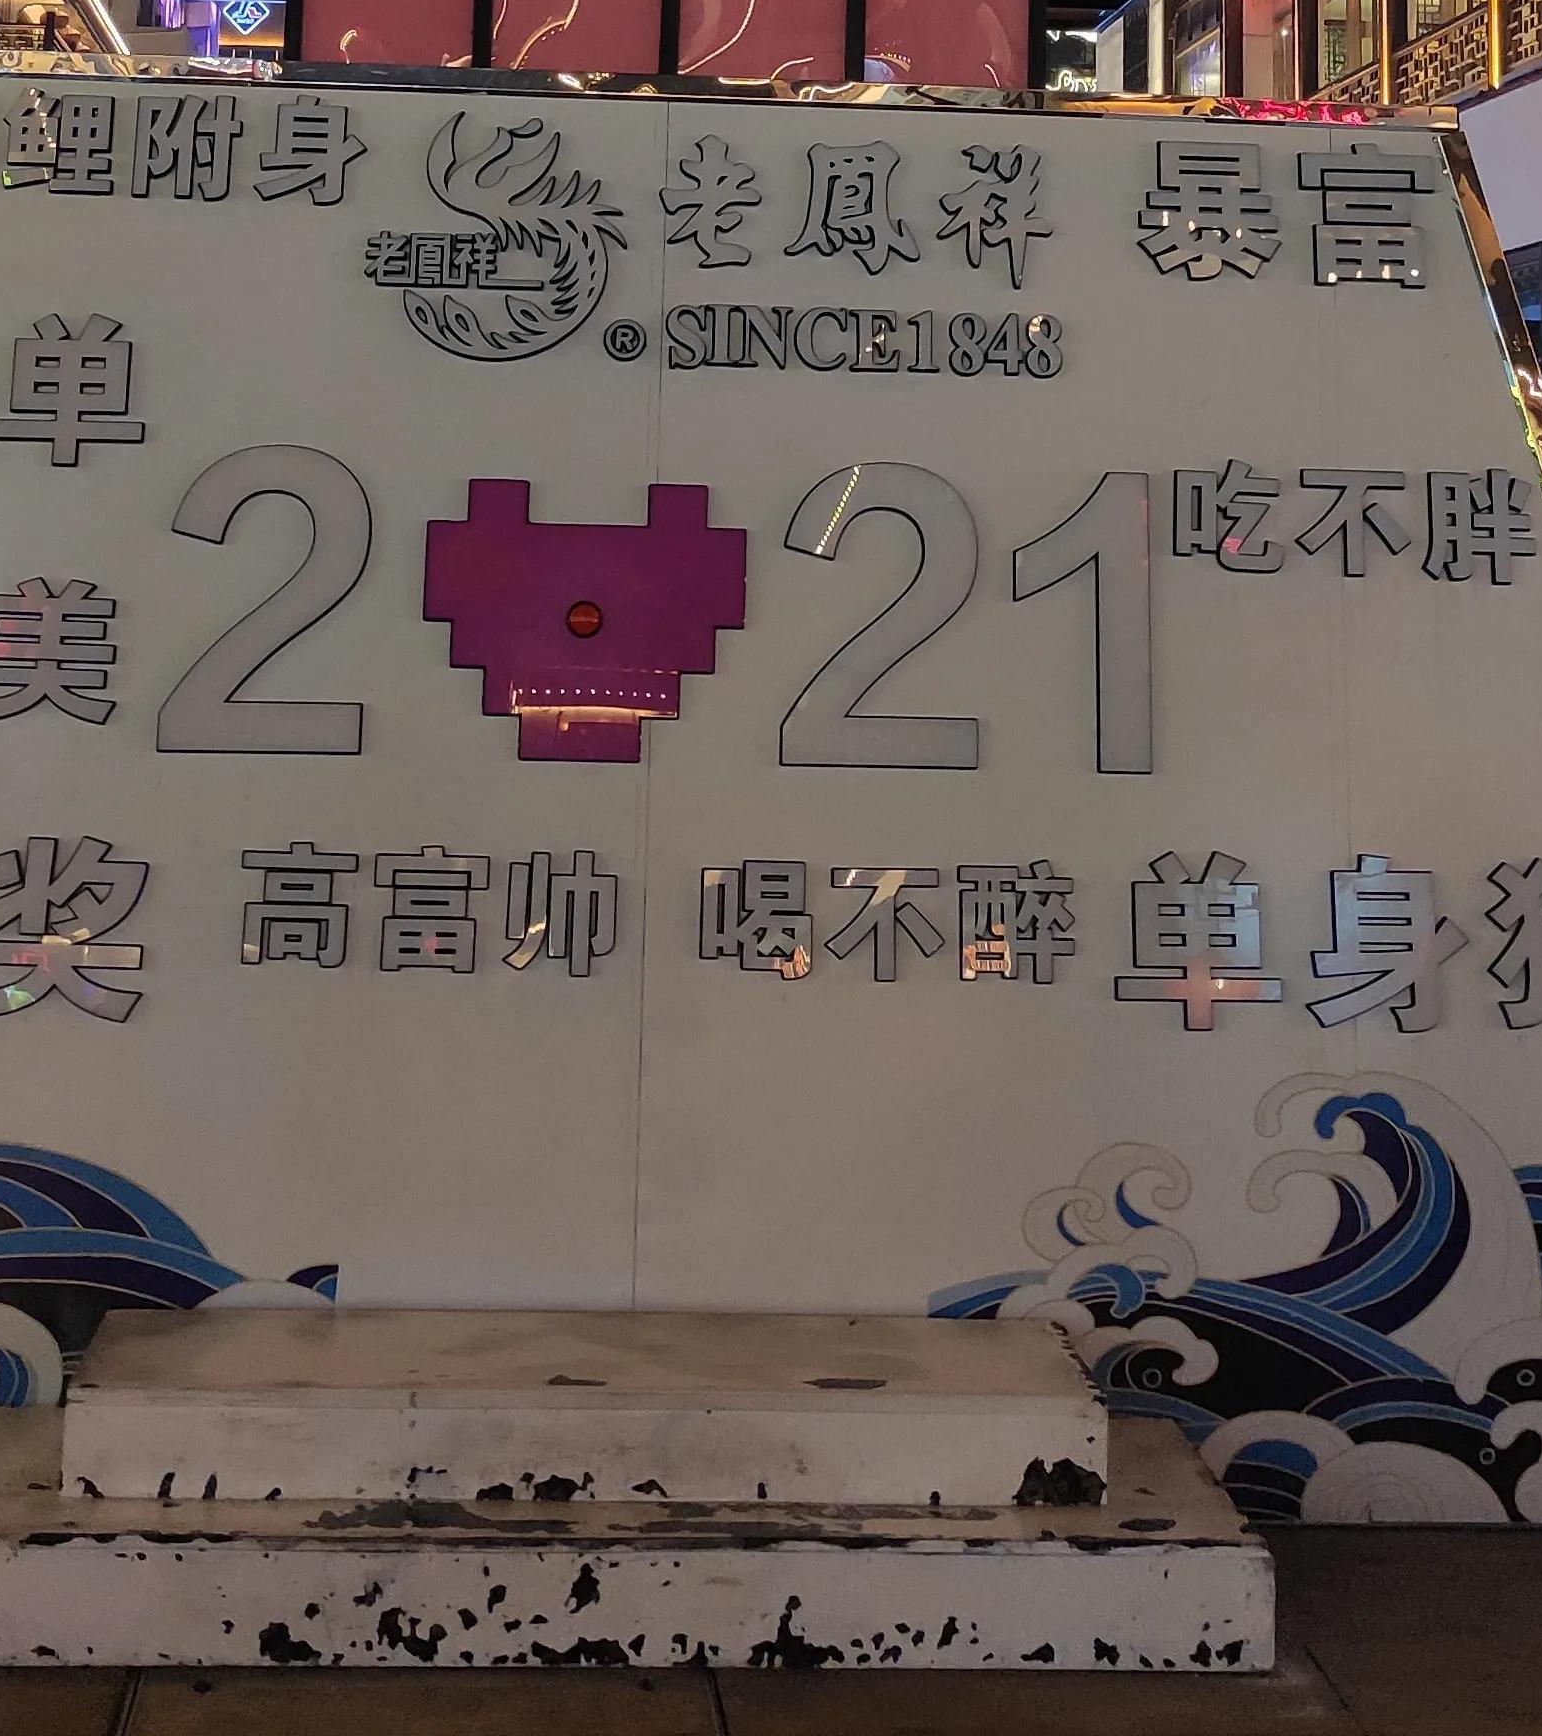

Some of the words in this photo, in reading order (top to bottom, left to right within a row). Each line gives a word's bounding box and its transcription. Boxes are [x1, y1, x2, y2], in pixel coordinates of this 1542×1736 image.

[1137, 140, 1435, 290] 暴富
[1172, 459, 1538, 586] 吃不胖
[240, 841, 620, 978] 高富帅
[698, 859, 1075, 985] 喝不醉
